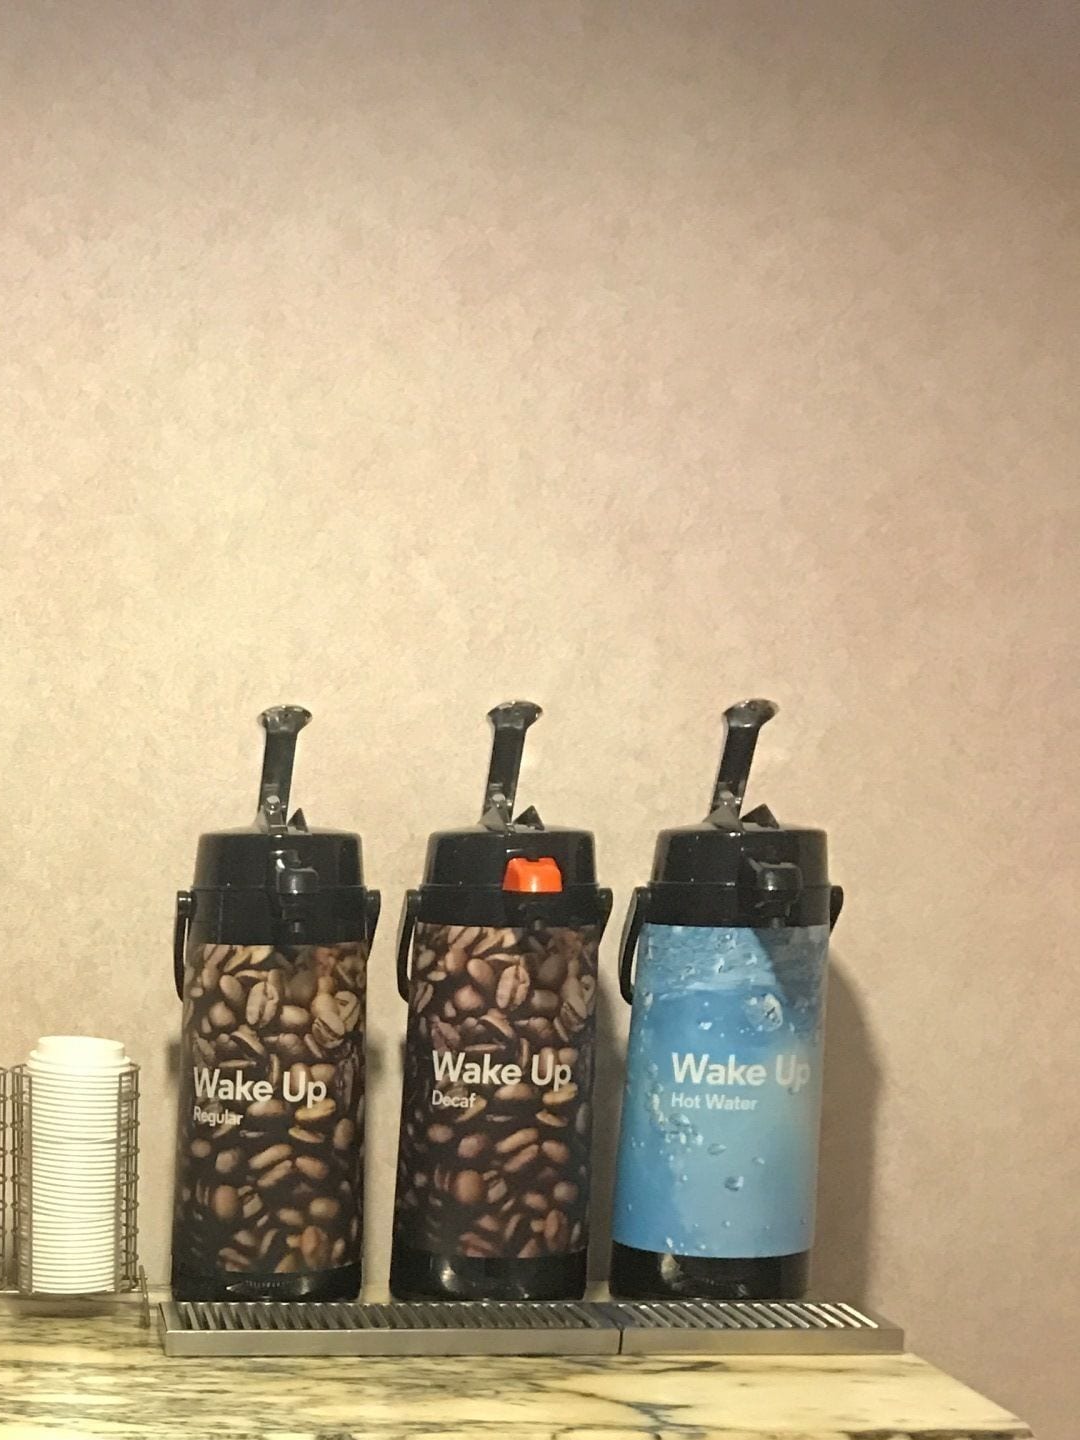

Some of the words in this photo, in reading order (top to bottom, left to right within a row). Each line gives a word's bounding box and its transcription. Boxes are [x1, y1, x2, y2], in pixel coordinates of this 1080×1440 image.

[432, 1050, 522, 1086] Wake
[531, 1053, 572, 1092] Up
[672, 1052, 768, 1087] Wake
[775, 1054, 811, 1094] Up
[193, 1066, 274, 1102] Wake
[283, 1070, 328, 1109] Up
[431, 1089, 477, 1109] Decaf
[671, 1091, 701, 1110] Hot
[705, 1093, 759, 1111] Water
[193, 1105, 244, 1127] Regular
